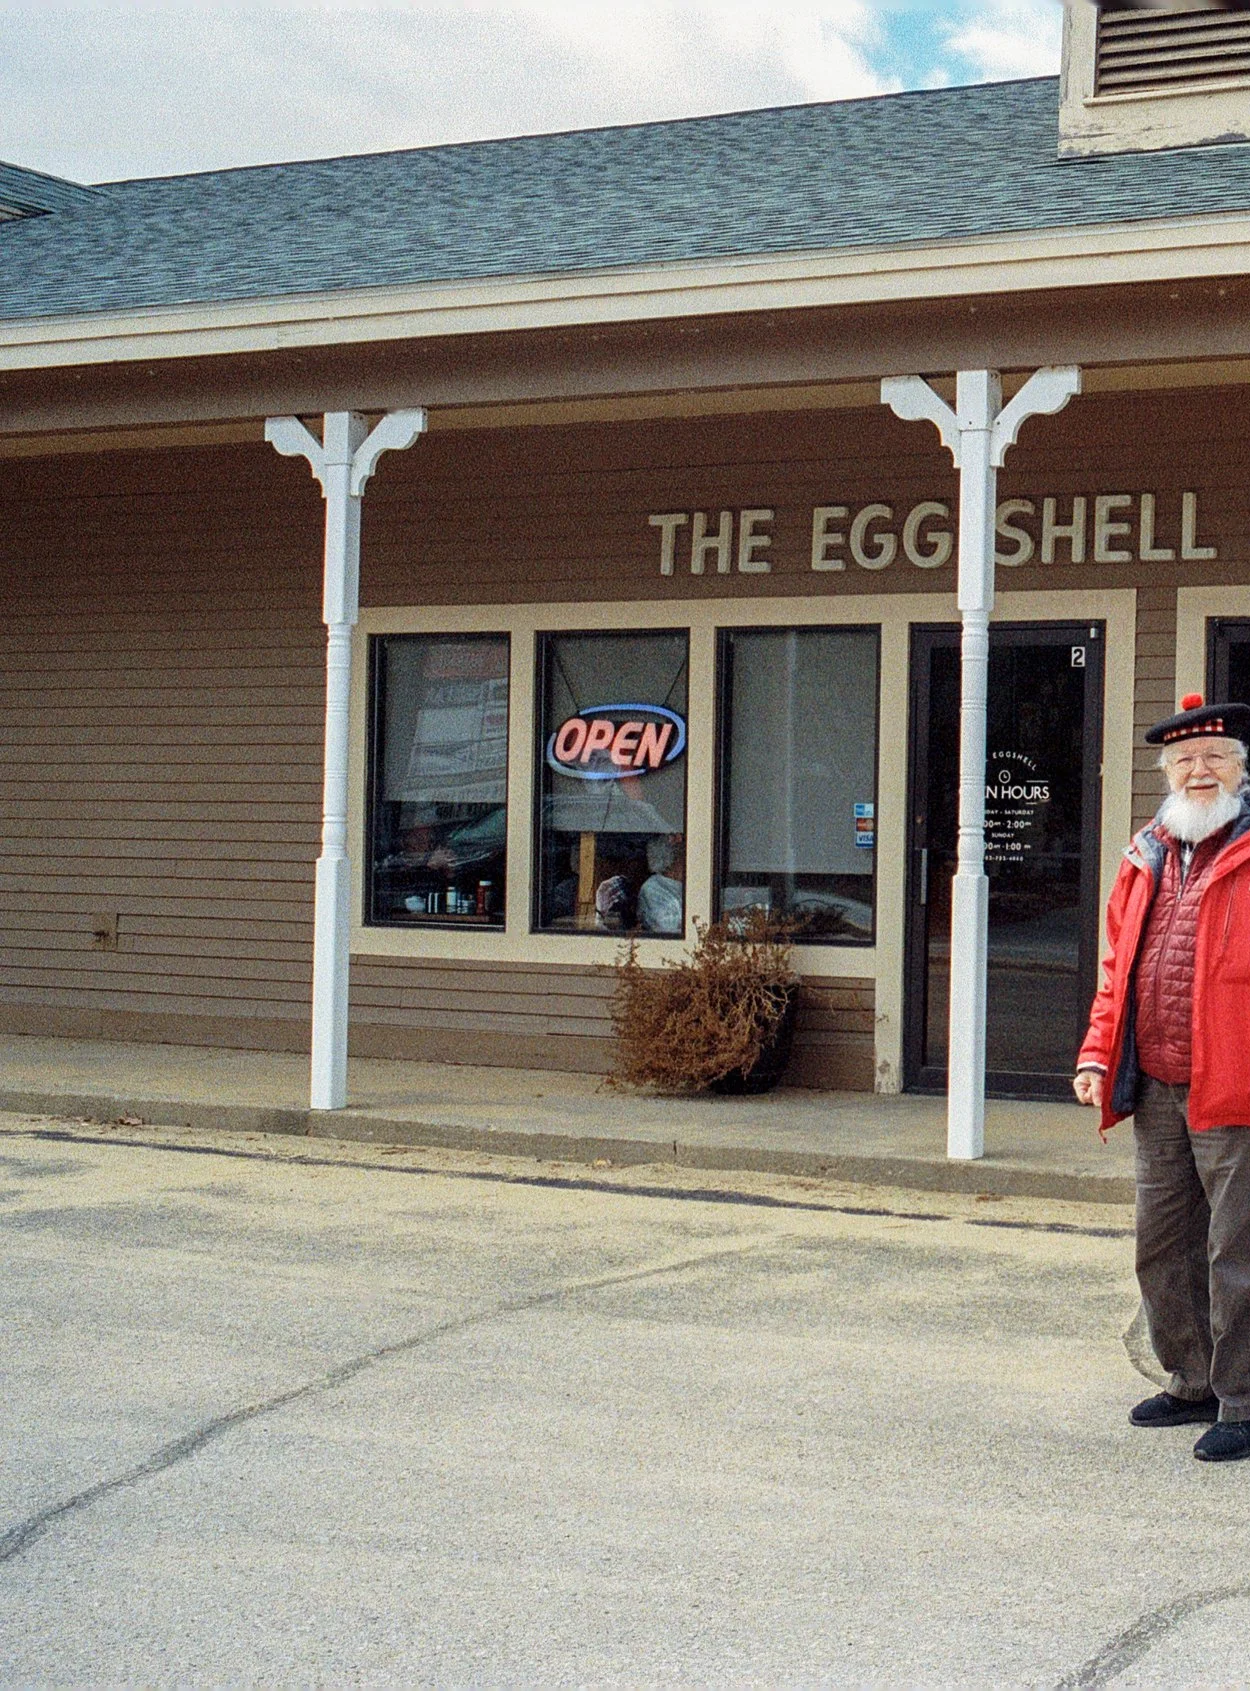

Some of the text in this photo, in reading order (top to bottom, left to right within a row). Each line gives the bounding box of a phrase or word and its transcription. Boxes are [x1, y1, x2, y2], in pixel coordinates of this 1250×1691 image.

[648, 510, 774, 576] THE
[1073, 648, 1084, 666] 2
[555, 718, 673, 768] OPEN
[992, 751, 1037, 771] EGGSHELL
[1001, 786, 1049, 800] HOURS
